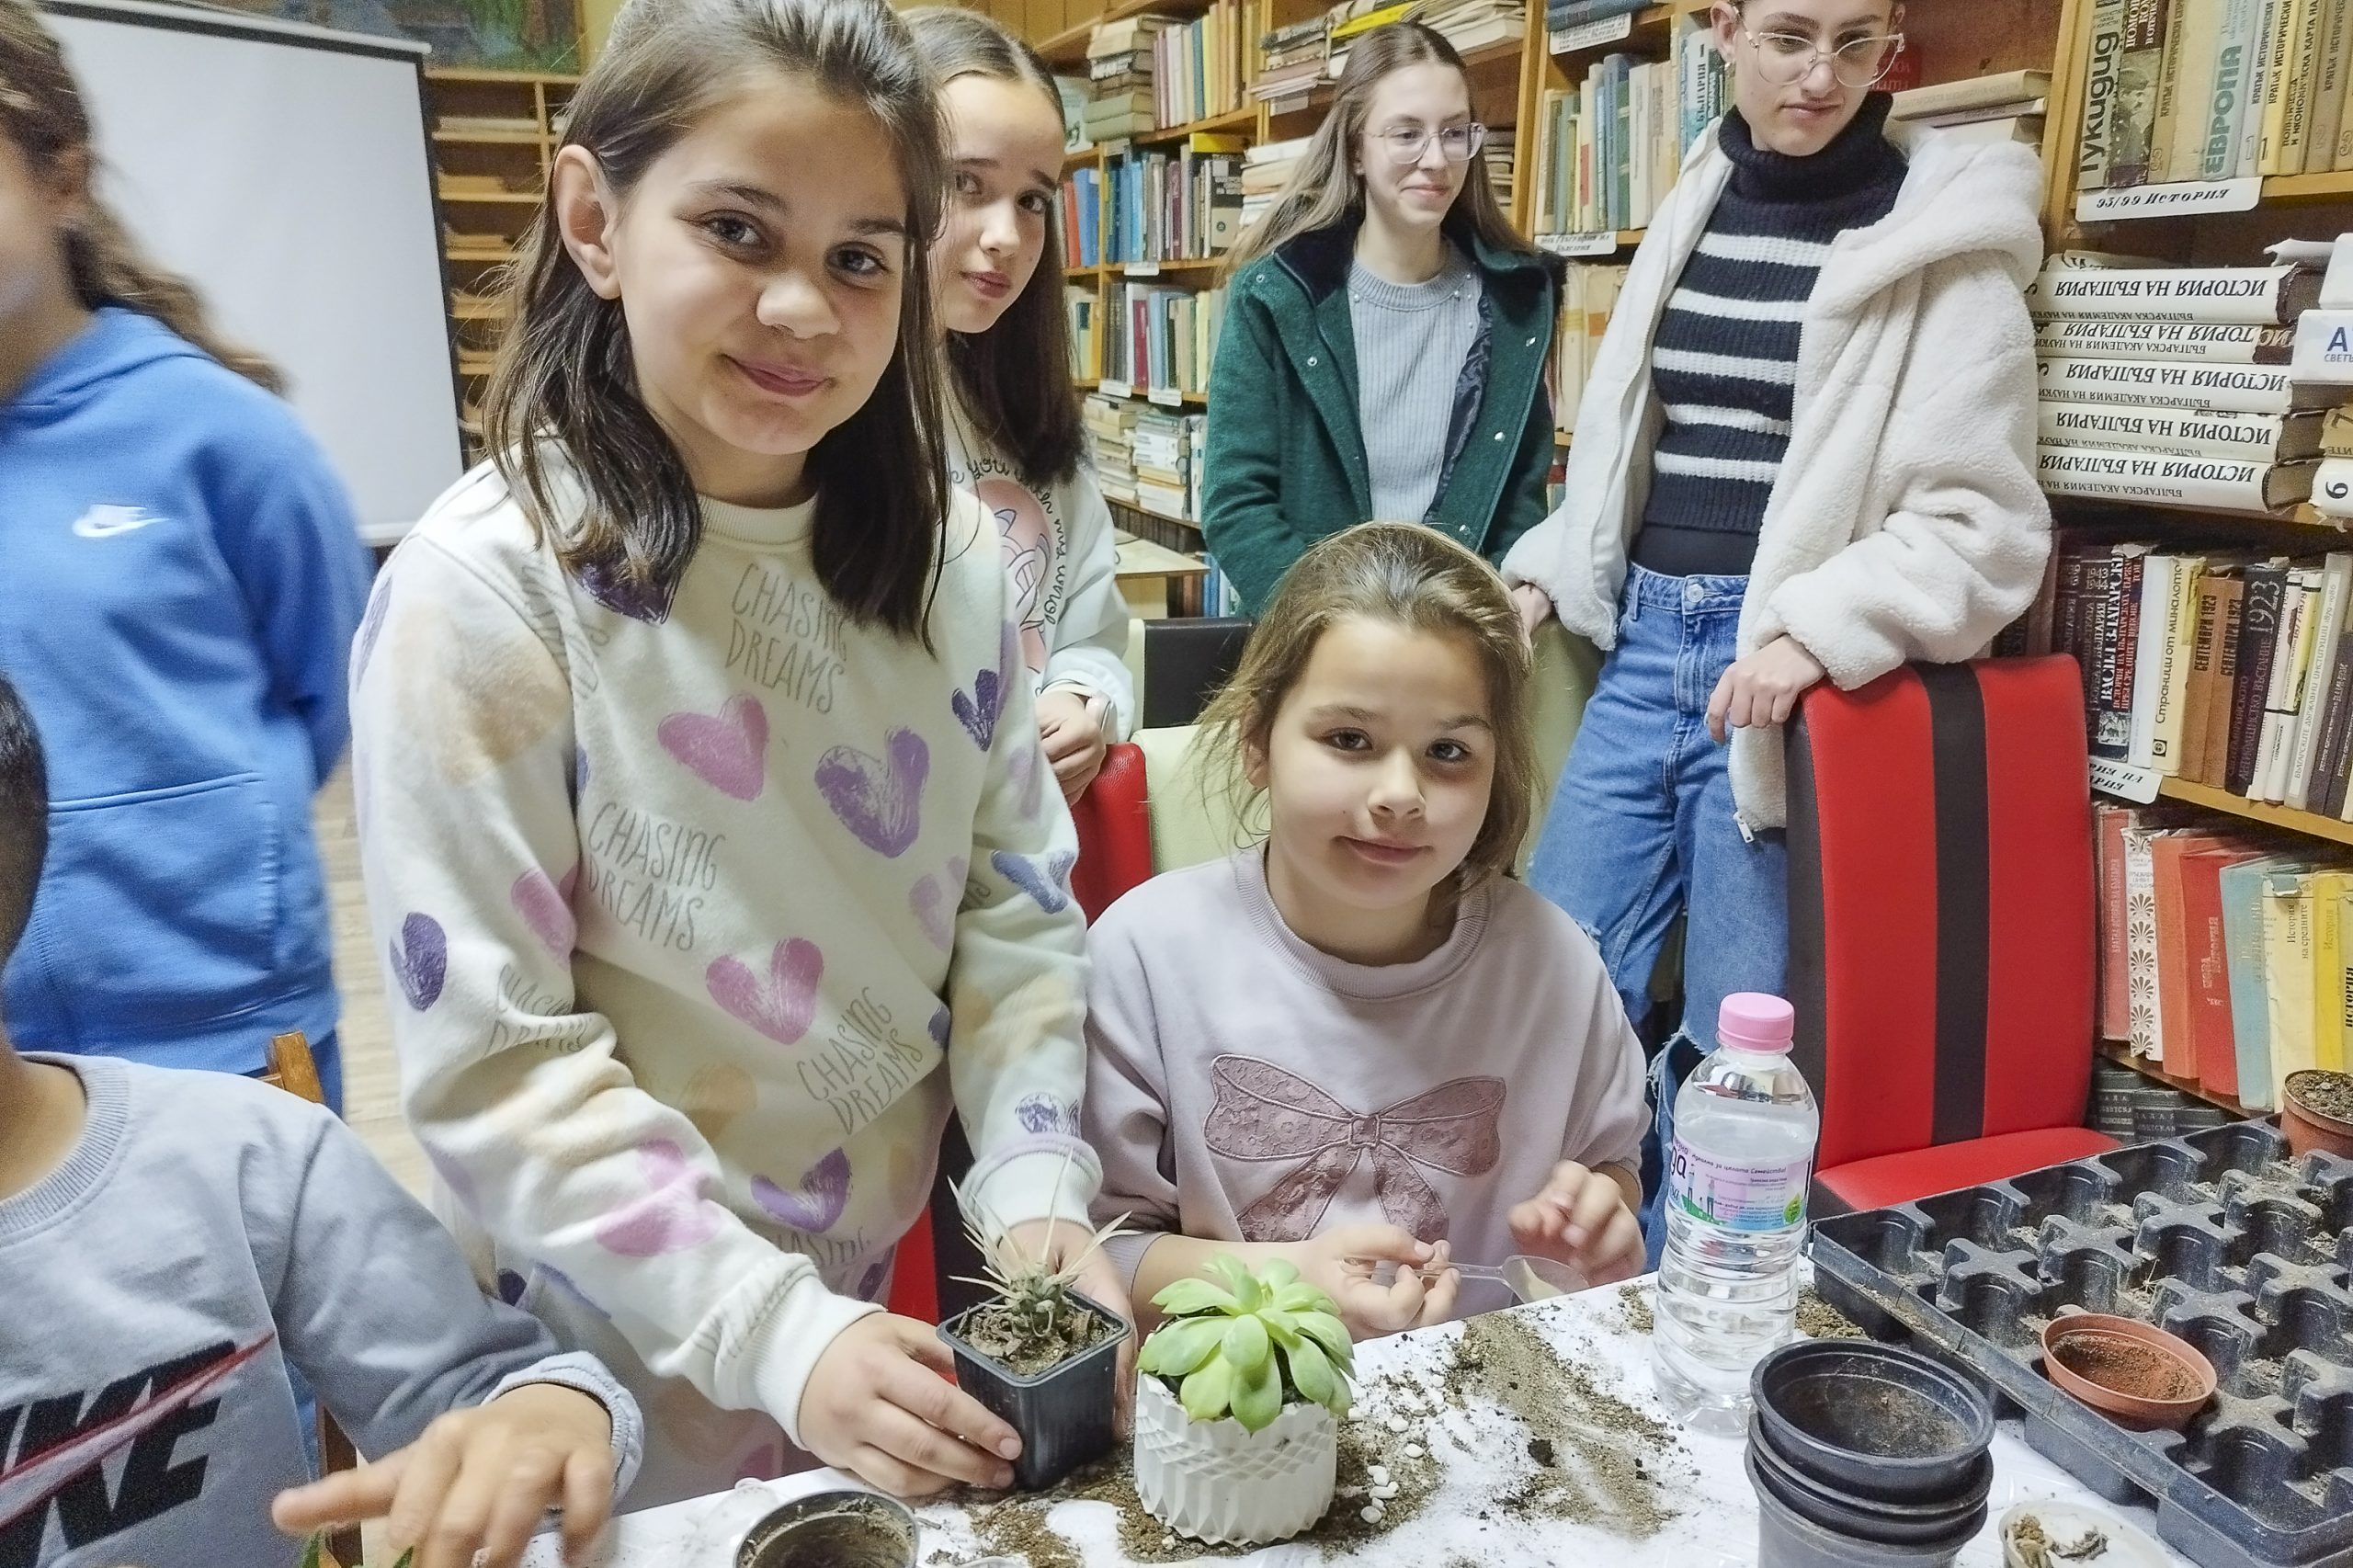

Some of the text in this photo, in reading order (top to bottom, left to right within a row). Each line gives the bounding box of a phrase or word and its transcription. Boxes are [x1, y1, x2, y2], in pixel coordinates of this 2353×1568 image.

[2304, 17, 2316, 51] КАРТА
[2204, 45, 2242, 174] ЕВРОПА
[2055, 280, 2142, 296] БЪЛГАРИЯ
[2146, 280, 2171, 296] НА
[2175, 279, 2268, 297] ИСТОРИЯ
[2063, 324, 2154, 340] БЪЛГАРИЯ
[2158, 324, 2185, 340] НА
[2070, 339, 2083, 349] НА
[2086, 341, 2143, 352] АКАДЕМИЯ
[2146, 343, 2207, 354] БЪЛГАРСКА
[2066, 364, 2157, 383] БЪЛГАРИЯ
[2161, 369, 2188, 385] НА
[2191, 370, 2287, 391] ИСТОРИЯ
[2073, 391, 2086, 399] НА
[2089, 392, 2147, 403] АКАДЕМИЯ
[2150, 394, 2211, 408] БЪЛГАРСКА
[2056, 413, 2272, 444] ИСТОРИЯ НА БЪЛГАРИЯ
[2038, 435, 2062, 445] НАУК
[2039, 455, 2256, 483] ИСТОРИЯ НА БЪЛГАРИЯ
[2046, 480, 2060, 489] НА
[2063, 482, 2120, 494] АКАДЕМИЯ
[2123, 485, 2183, 498] БЪЛГАРСКА
[2246, 580, 2281, 634] 1923
[2194, 595, 2217, 672] СЕПТЕМВРИ 1923
[2155, 564, 2182, 724] Страници от миналото
[725, 617, 845, 714] DREAMS
[2100, 648, 2116, 700] ВАСИЛ
[2294, 729, 2311, 779] БЪЛГАРСКИТЕ
[2305, 682, 2319, 727] ДЪРЖАВНИ
[2121, 772, 2143, 783] НА
[588, 801, 726, 892] CHASING
[587, 852, 703, 951] DREAMS
[2287, 904, 2297, 944] История
[2299, 903, 2311, 960] на средните
[797, 986, 892, 1101] CHASING
[827, 1028, 923, 1135] DREAMS
